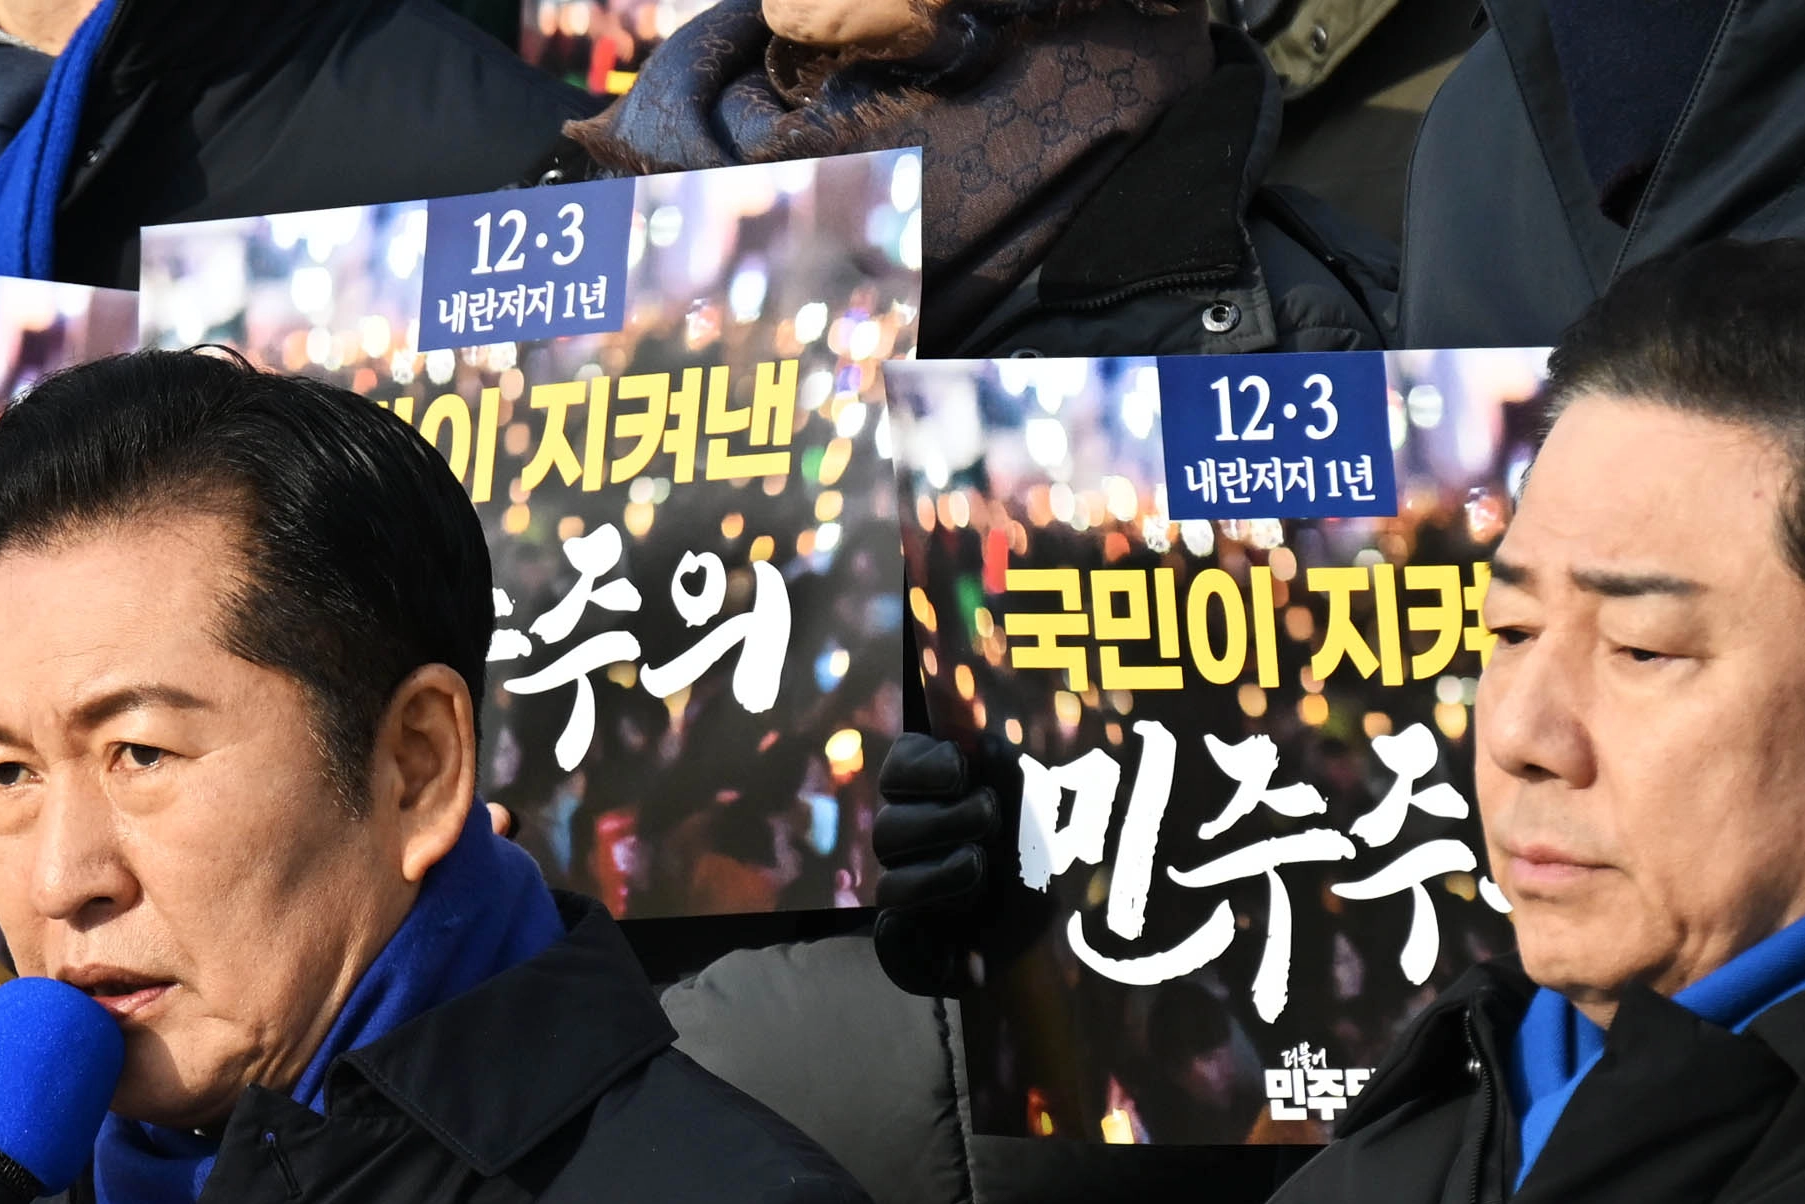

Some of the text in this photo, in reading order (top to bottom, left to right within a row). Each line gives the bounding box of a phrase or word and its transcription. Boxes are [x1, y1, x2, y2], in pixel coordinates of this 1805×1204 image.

[437, 273, 608, 334] 내란저지 1년
[521, 358, 799, 492] 지켜낸
[1184, 454, 1377, 505] 내란저지 1년
[1002, 567, 1280, 692] 국민이
[1017, 719, 1514, 1025] 민주주
[1280, 1040, 1328, 1072] 더불어
